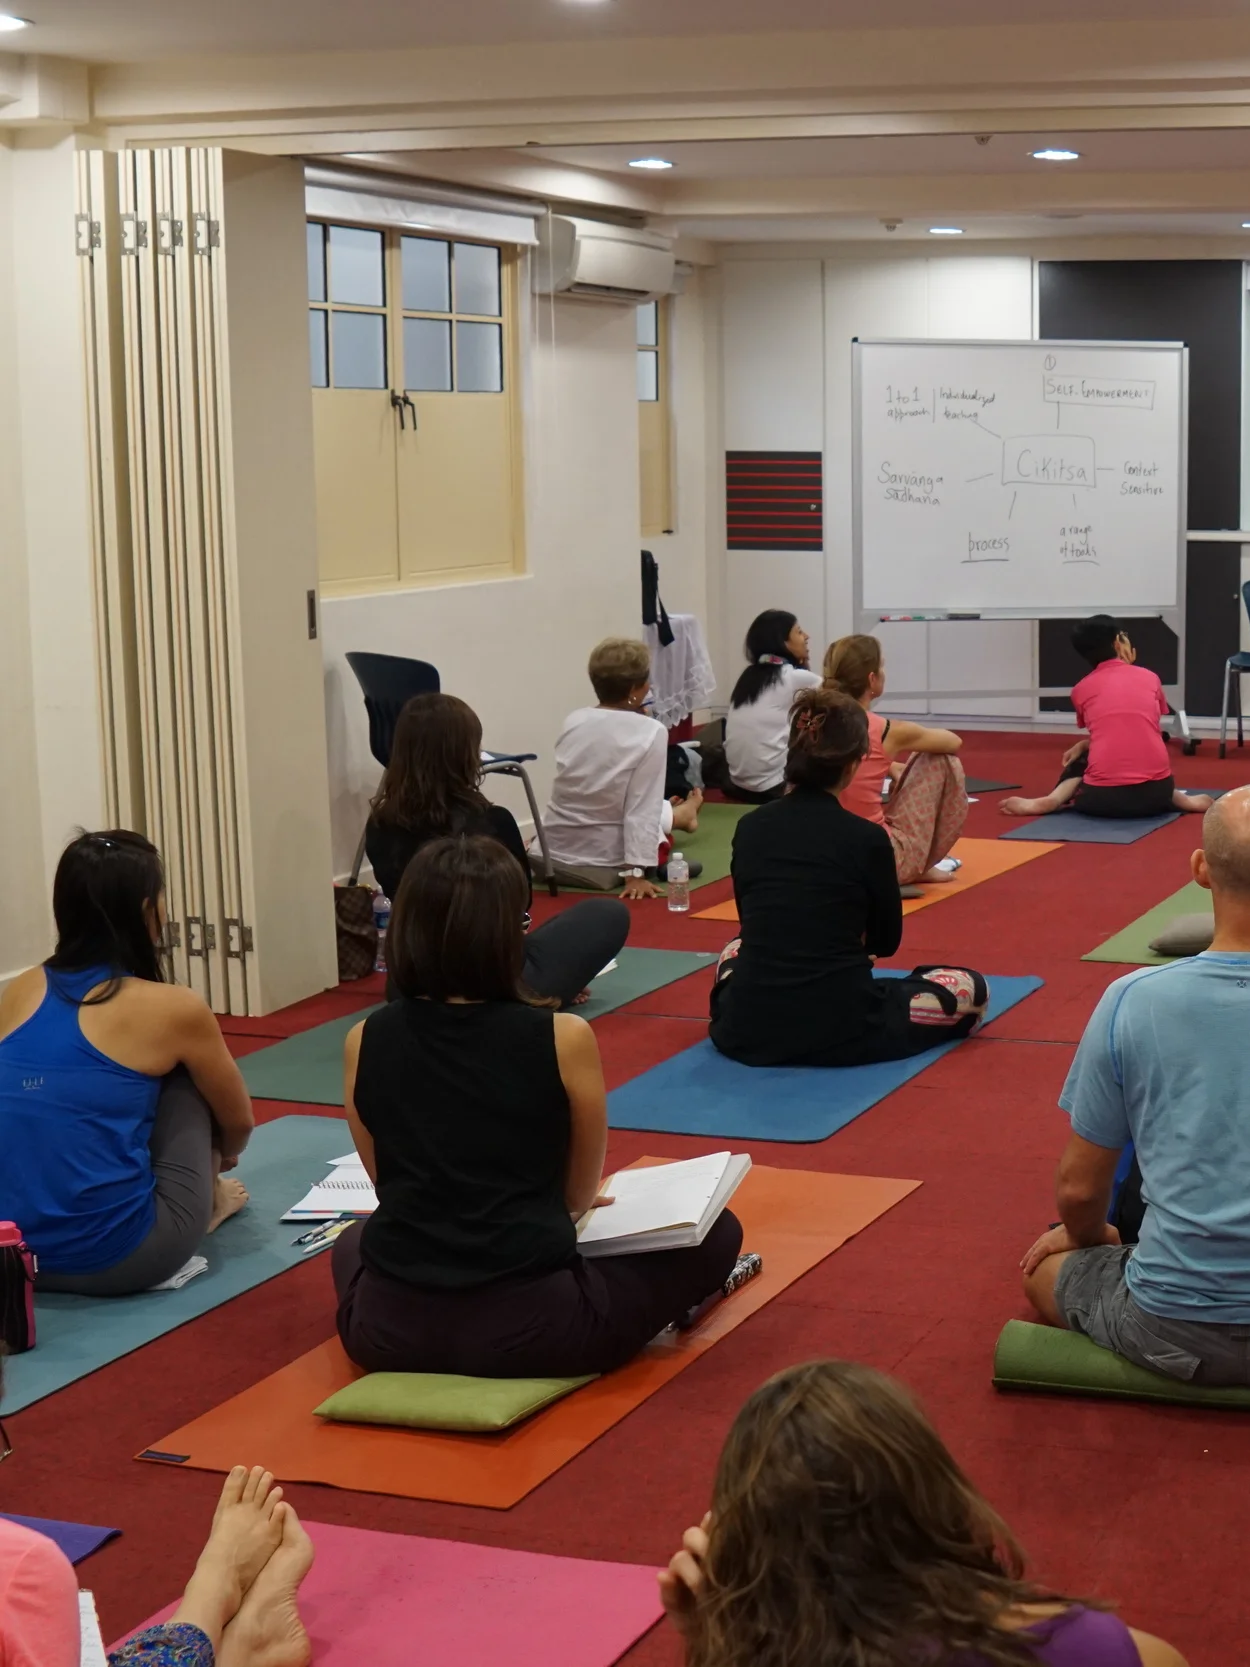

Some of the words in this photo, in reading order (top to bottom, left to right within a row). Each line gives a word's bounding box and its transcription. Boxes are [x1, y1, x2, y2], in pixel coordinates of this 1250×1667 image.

[886, 385, 893, 403] 1
[896, 390, 910, 404] to
[913, 386, 920, 402] 1
[968, 532, 1010, 560] process
